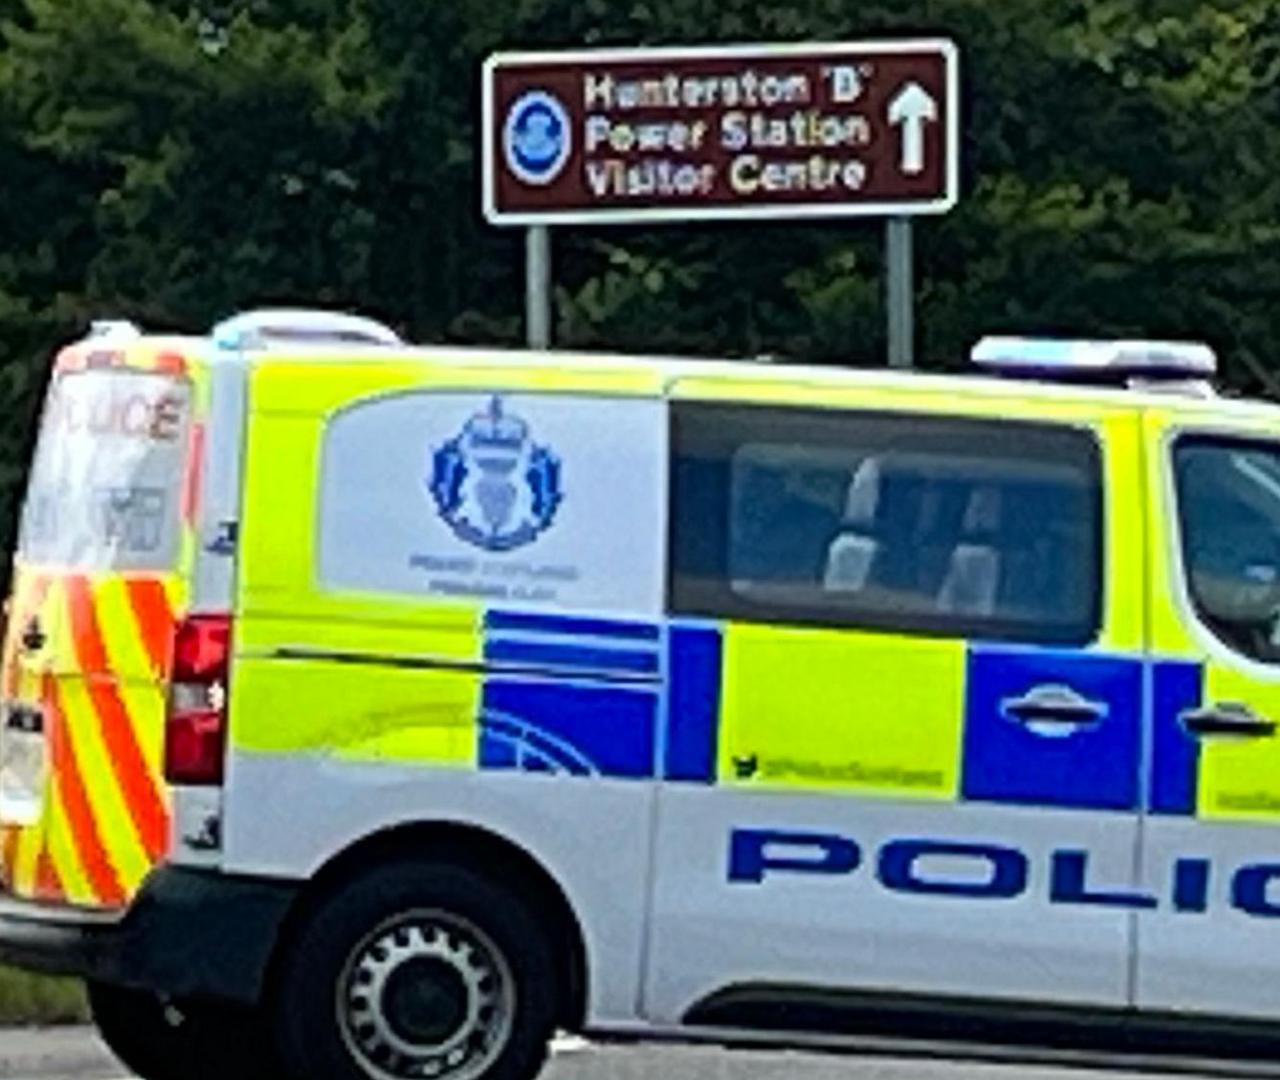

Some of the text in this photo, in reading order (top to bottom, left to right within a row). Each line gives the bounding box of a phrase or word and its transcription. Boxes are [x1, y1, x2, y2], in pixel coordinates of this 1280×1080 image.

[584, 70, 808, 110] Hunterston
[584, 109, 871, 151] Power Station
[585, 153, 867, 195] Visitor Centre
